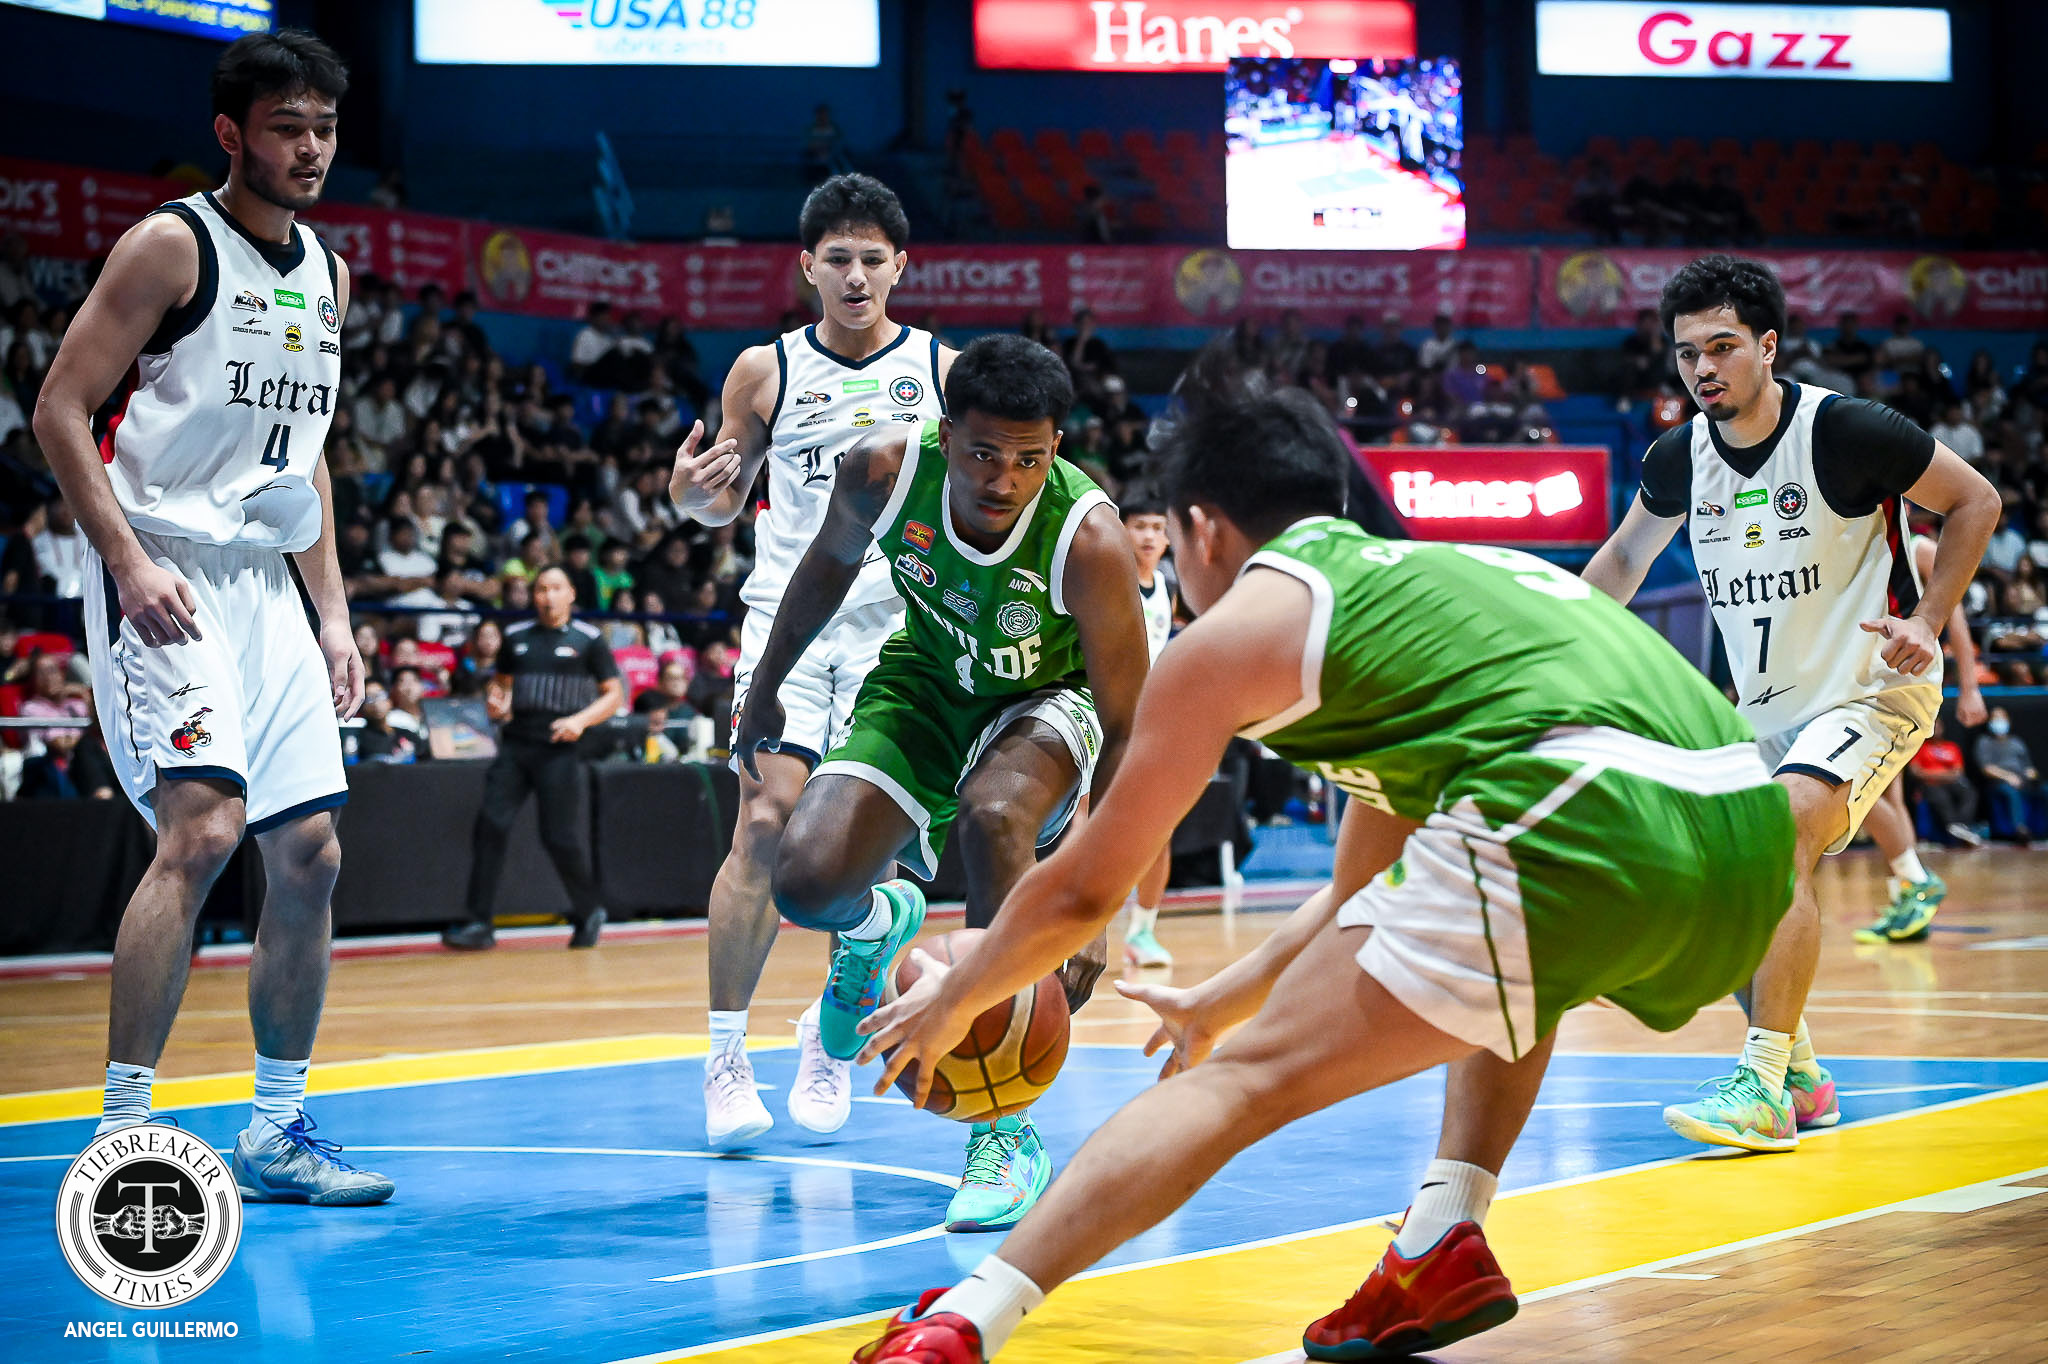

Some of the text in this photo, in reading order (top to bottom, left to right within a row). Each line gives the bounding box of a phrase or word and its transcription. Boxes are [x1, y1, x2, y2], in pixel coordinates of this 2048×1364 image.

[590, 0, 757, 29] USA 88
[1090, 1, 1296, 64] Hanes
[1638, 11, 1853, 69] Gazz
[893, 258, 1041, 290] HITOK'S
[225, 360, 338, 416] Letra
[260, 423, 292, 474] 4
[1390, 470, 1534, 518] Hanes
[1778, 525, 1811, 541] SGA
[1008, 578, 1033, 593] ANTA
[1702, 562, 1822, 608] Letran
[1752, 616, 1772, 674] 7
[1825, 726, 1863, 763] 7
